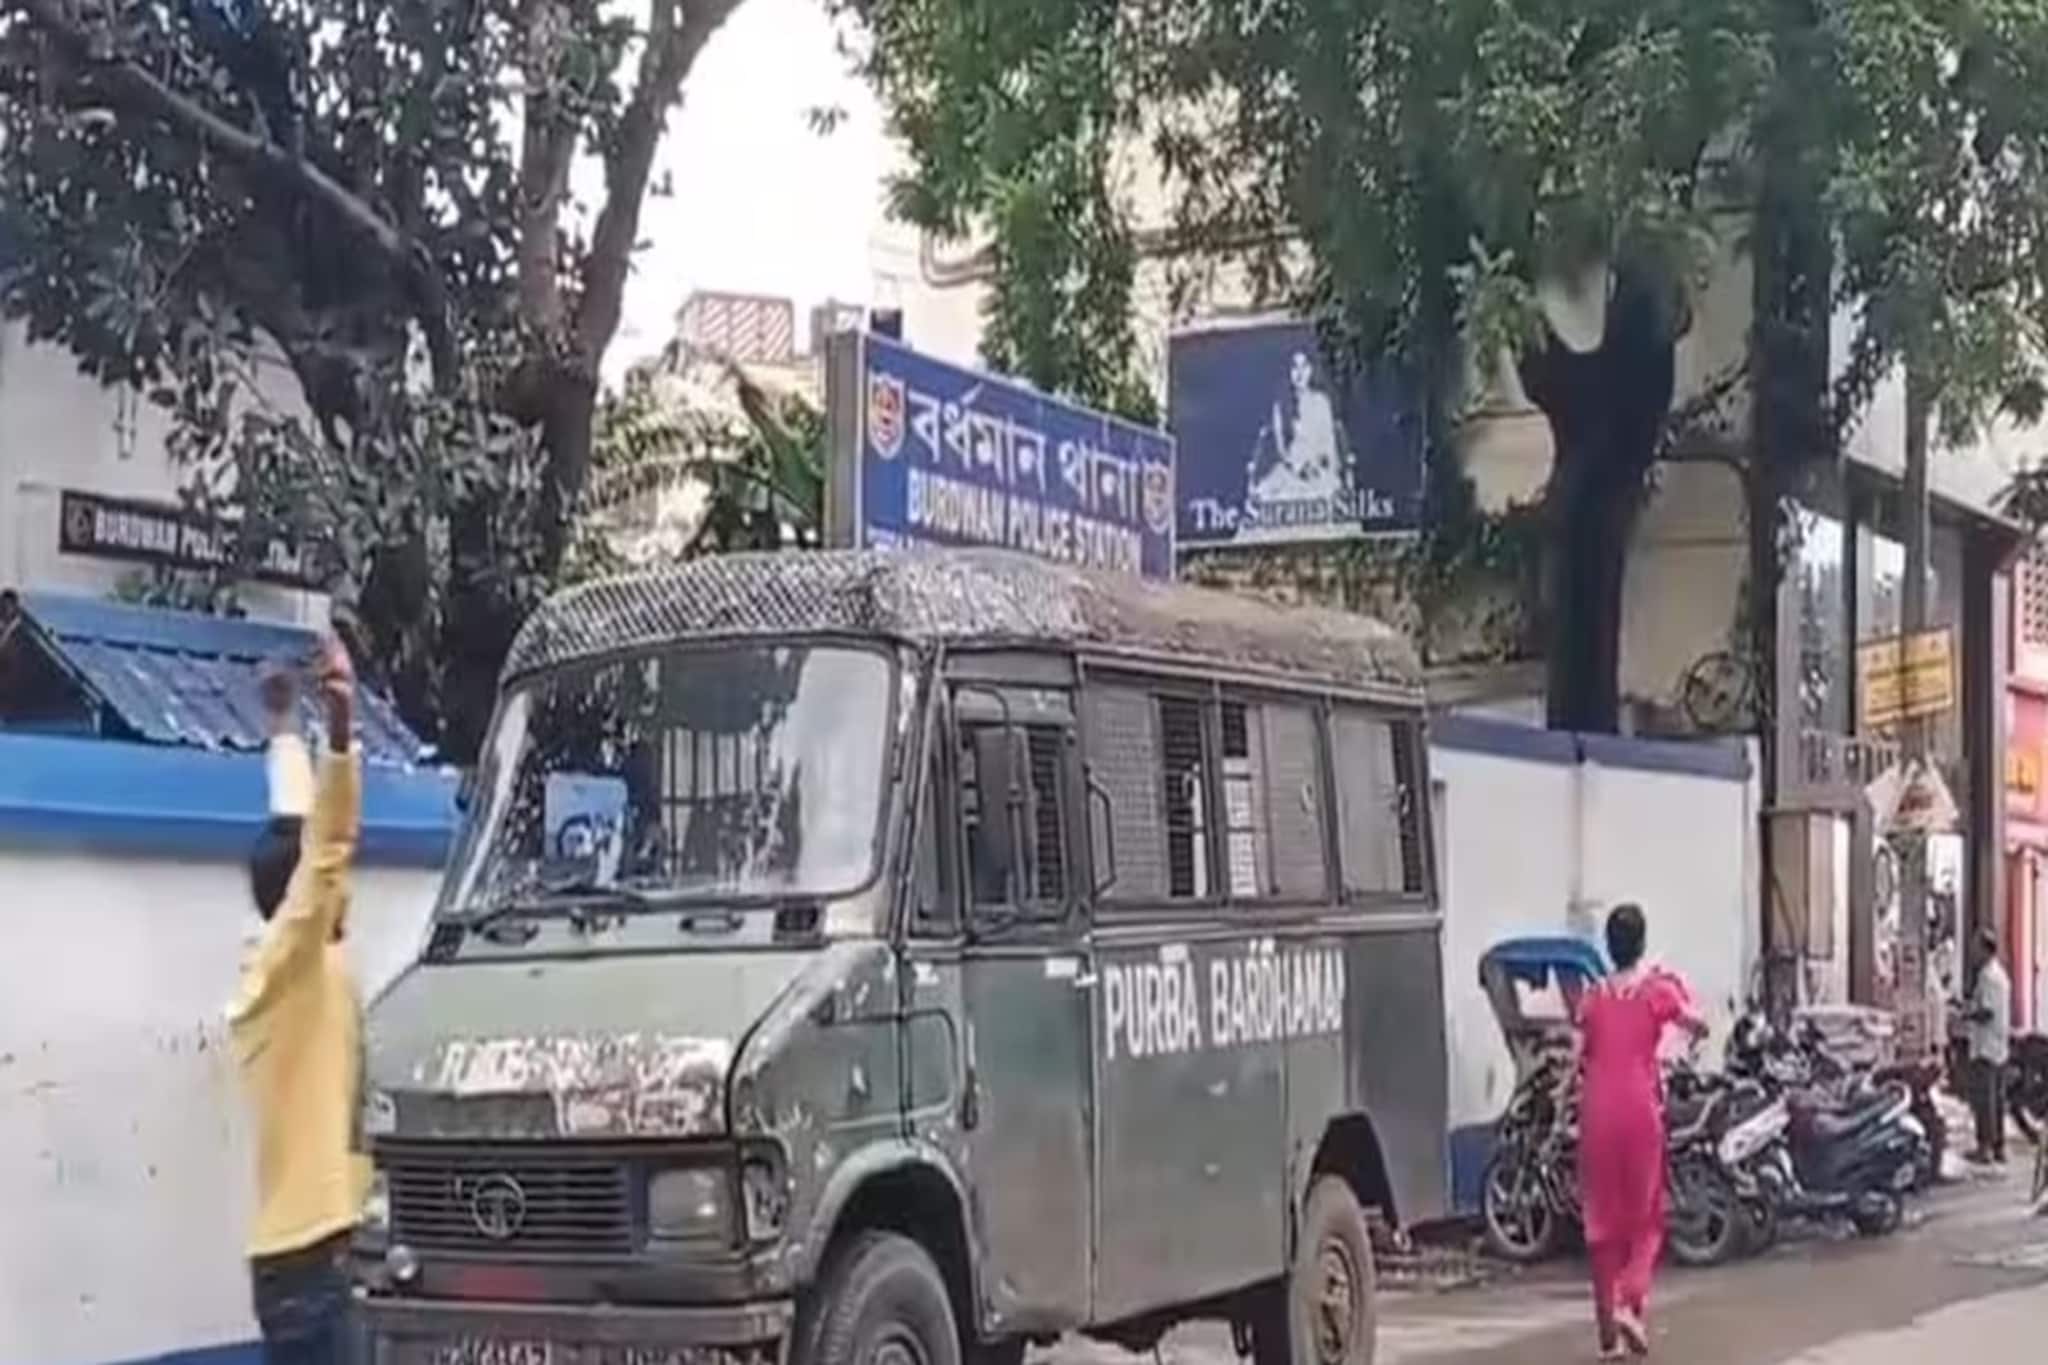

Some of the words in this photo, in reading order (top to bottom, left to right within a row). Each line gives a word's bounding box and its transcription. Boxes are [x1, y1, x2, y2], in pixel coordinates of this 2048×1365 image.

[907, 381, 1046, 495] বর্ধমান
[1058, 437, 1140, 523] থানা
[907, 467, 1004, 543] BURDWAN
[1007, 494, 1070, 560] POLICE
[1188, 498, 1238, 530] The
[1331, 488, 1395, 521] Silks
[1104, 961, 1201, 1060] PURBA
